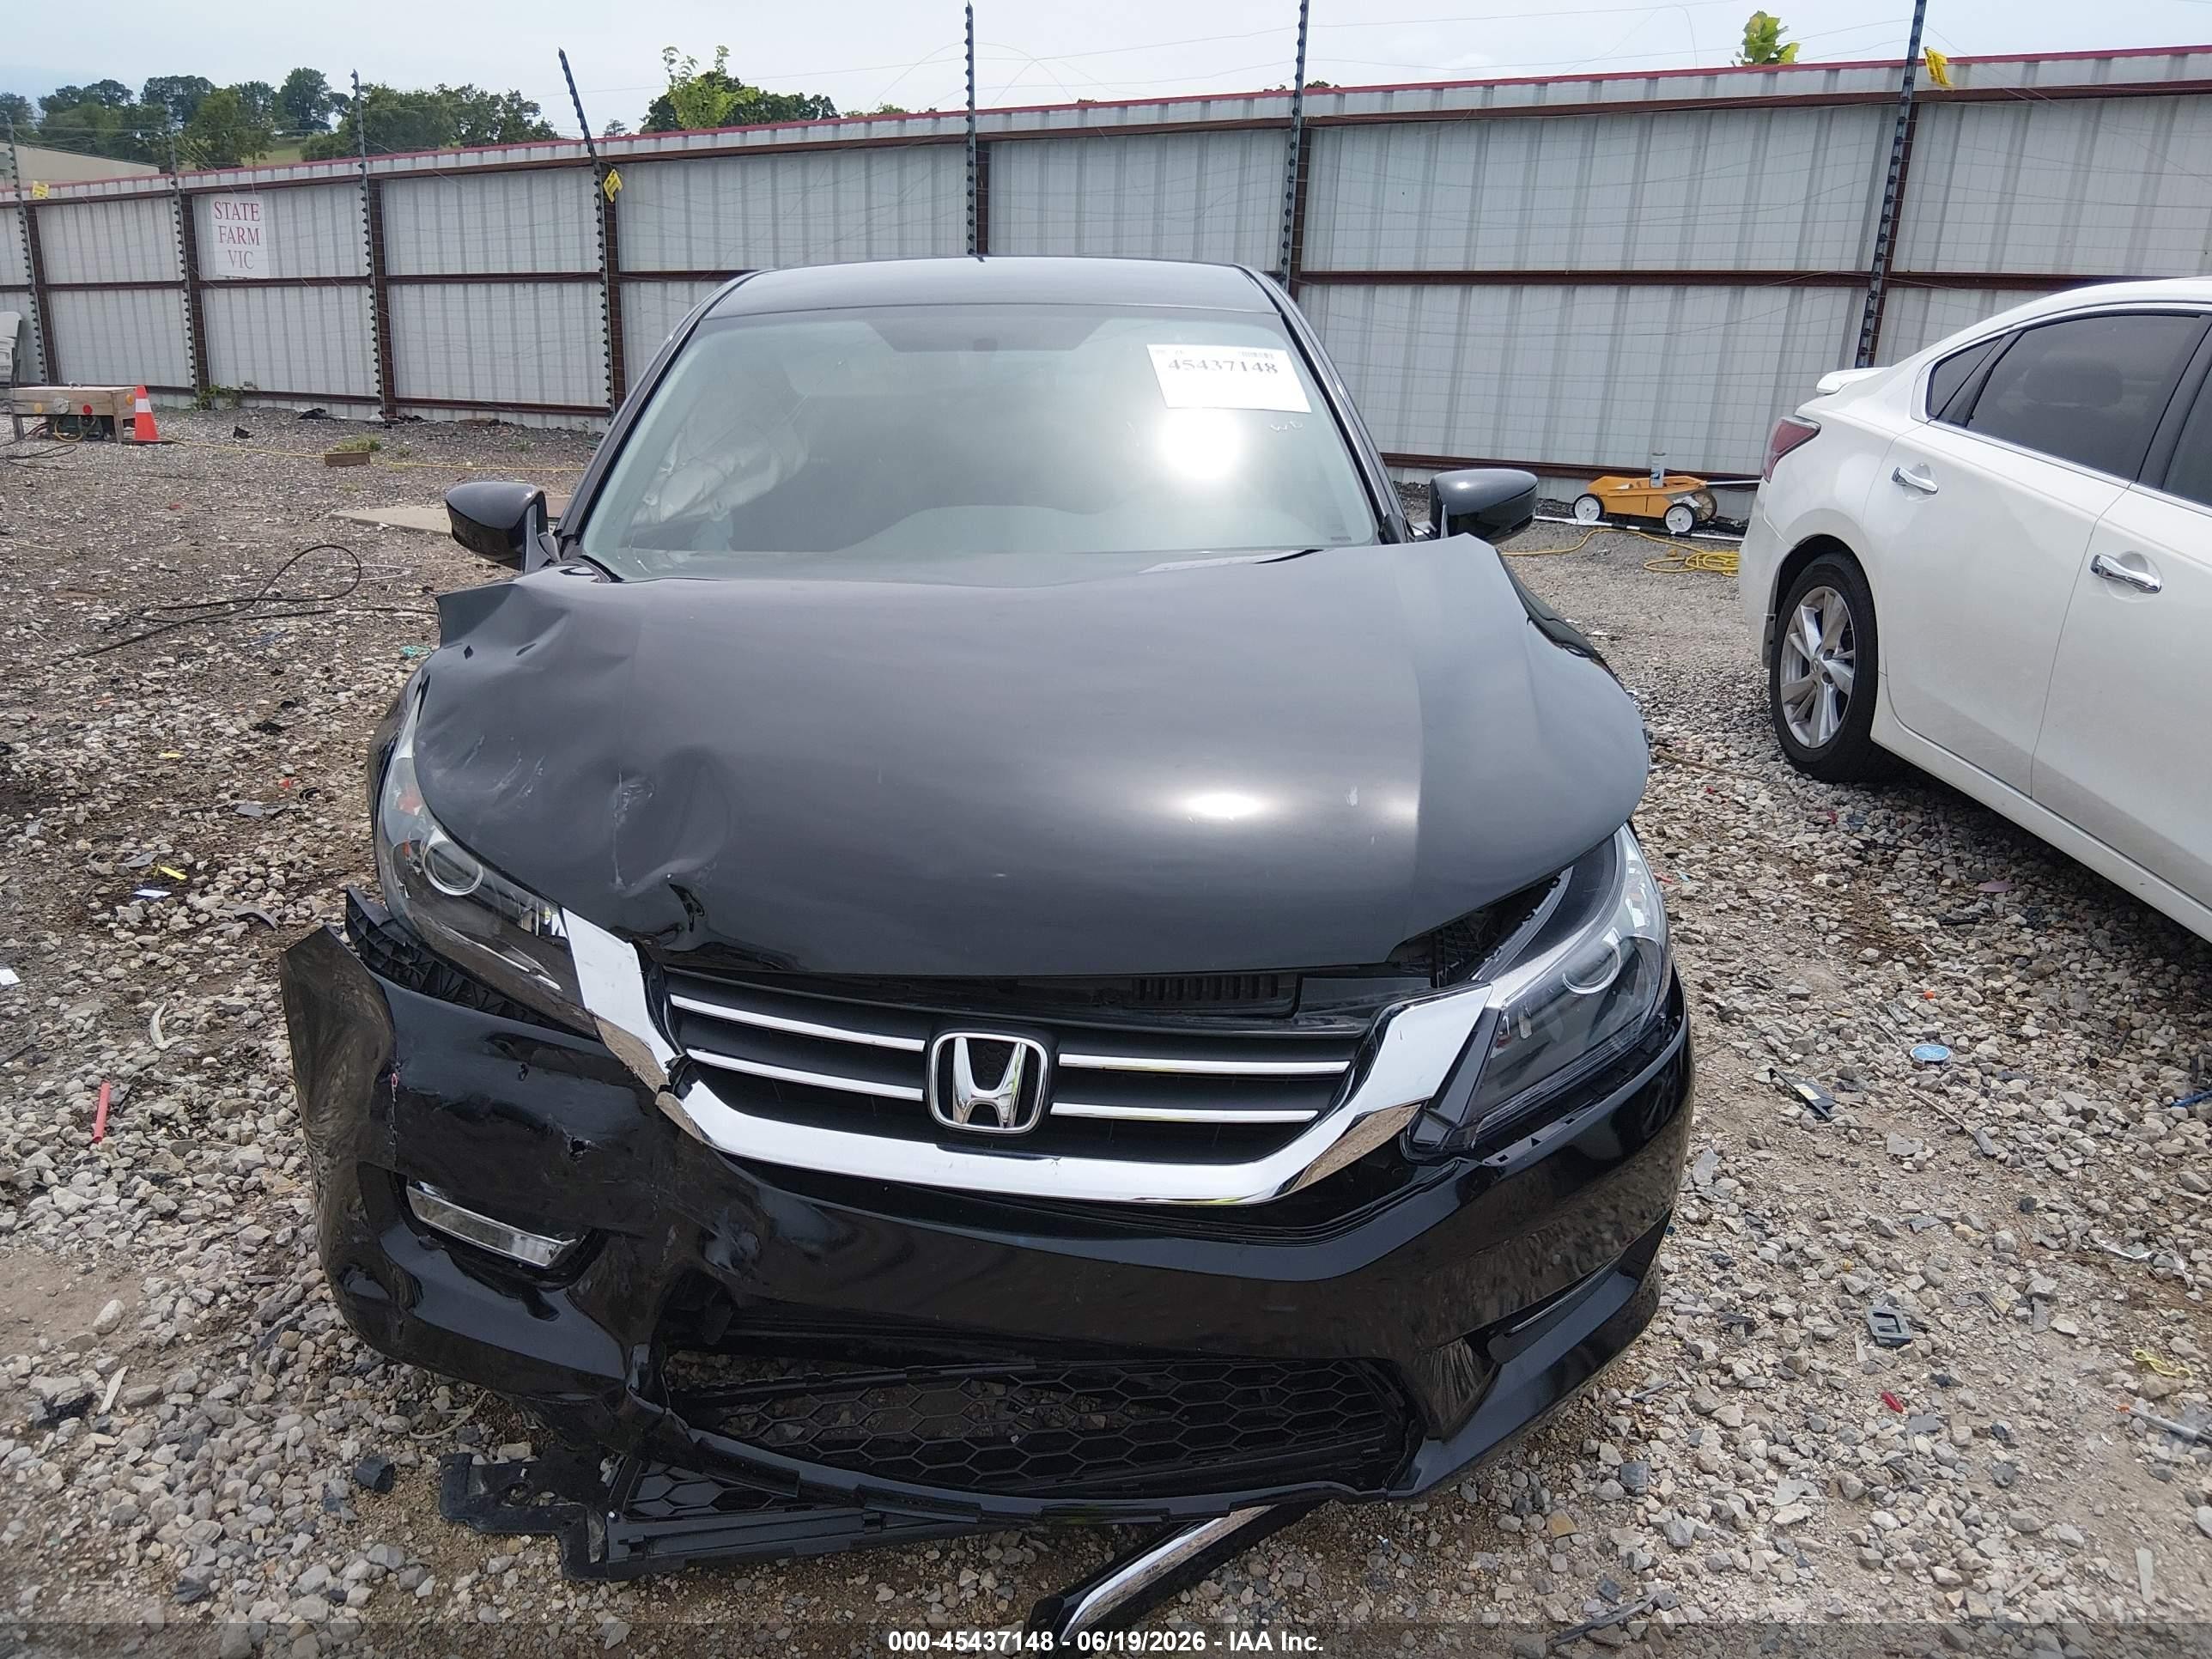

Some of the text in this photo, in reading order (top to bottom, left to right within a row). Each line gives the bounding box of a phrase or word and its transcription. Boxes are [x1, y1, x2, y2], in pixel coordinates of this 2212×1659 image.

[214, 201, 260, 222] STATE
[218, 225, 260, 246] FARM
[228, 249, 255, 270] VIC
[1168, 359, 1279, 374] 45437148
